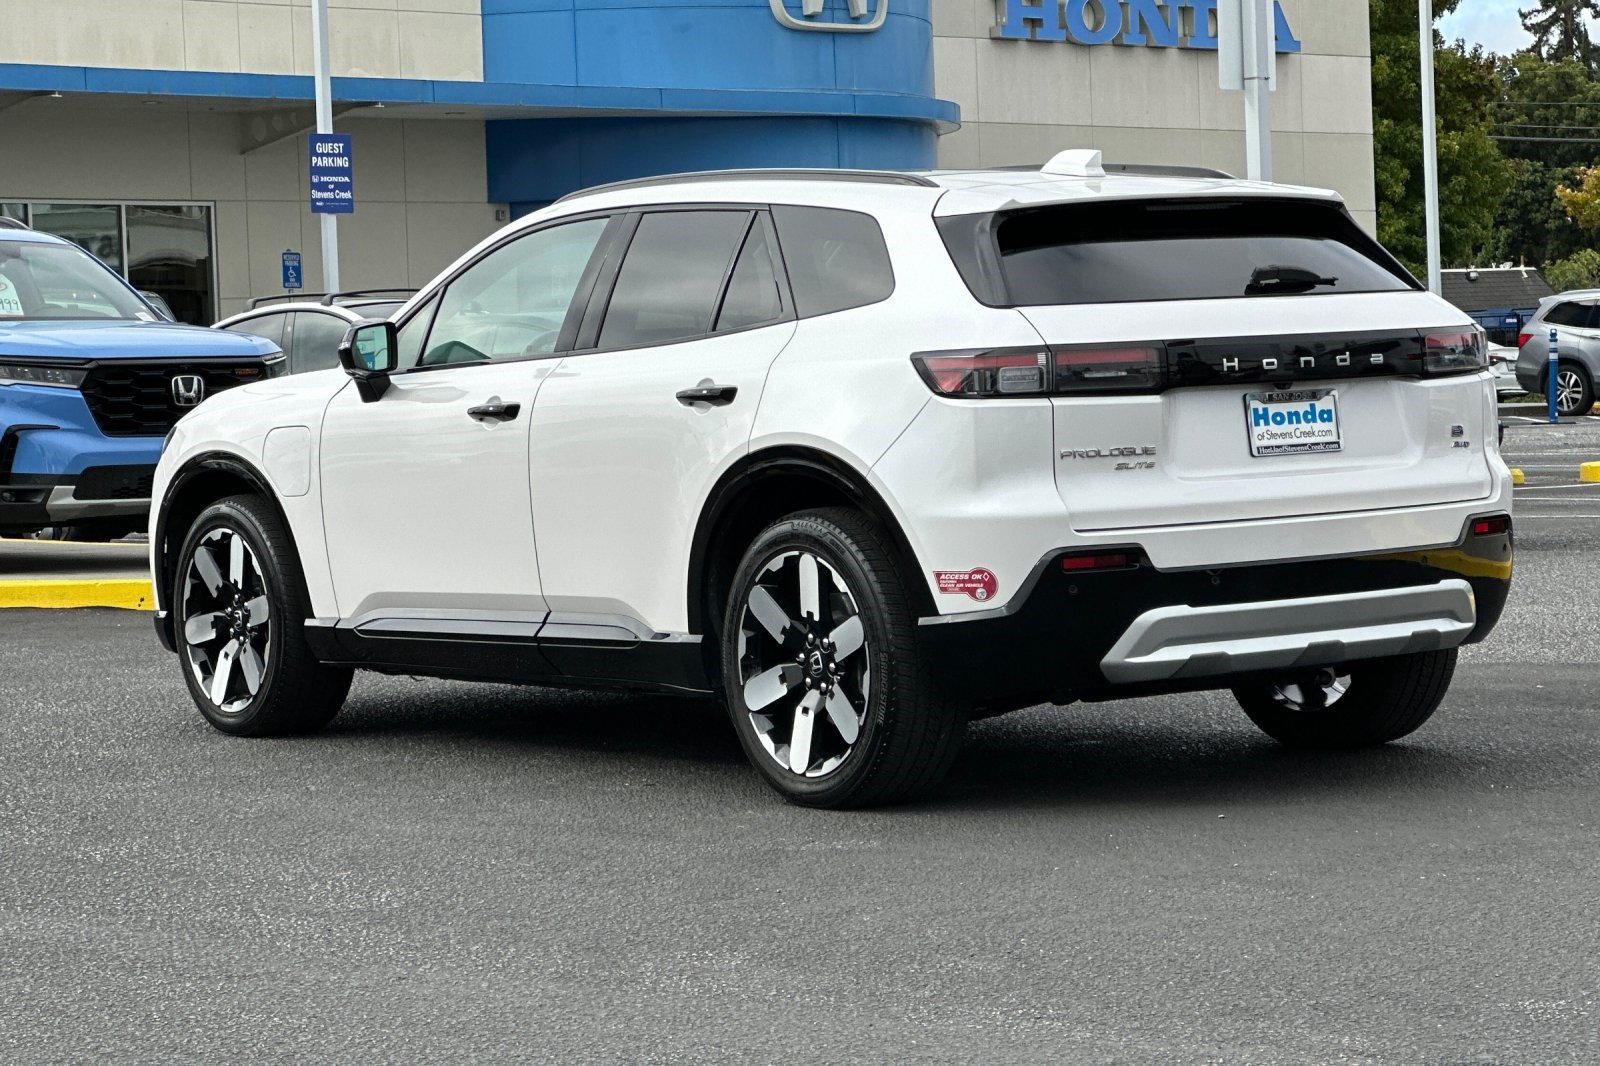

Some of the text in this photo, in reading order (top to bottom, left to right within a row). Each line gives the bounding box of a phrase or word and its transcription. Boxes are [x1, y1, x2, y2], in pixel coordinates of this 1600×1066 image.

[1000, 0, 1300, 52] HON
[316, 142, 344, 154] GUEST
[311, 156, 349, 168] PARKING
[311, 189, 352, 199] Stevens Creek
[1222, 351, 1384, 372] Honda
[1272, 392, 1312, 401] SAN JOSE
[1252, 403, 1333, 427] Honda
[1257, 425, 1332, 441] of Stevens Creek.com
[1060, 446, 1156, 459] PROLOGUE
